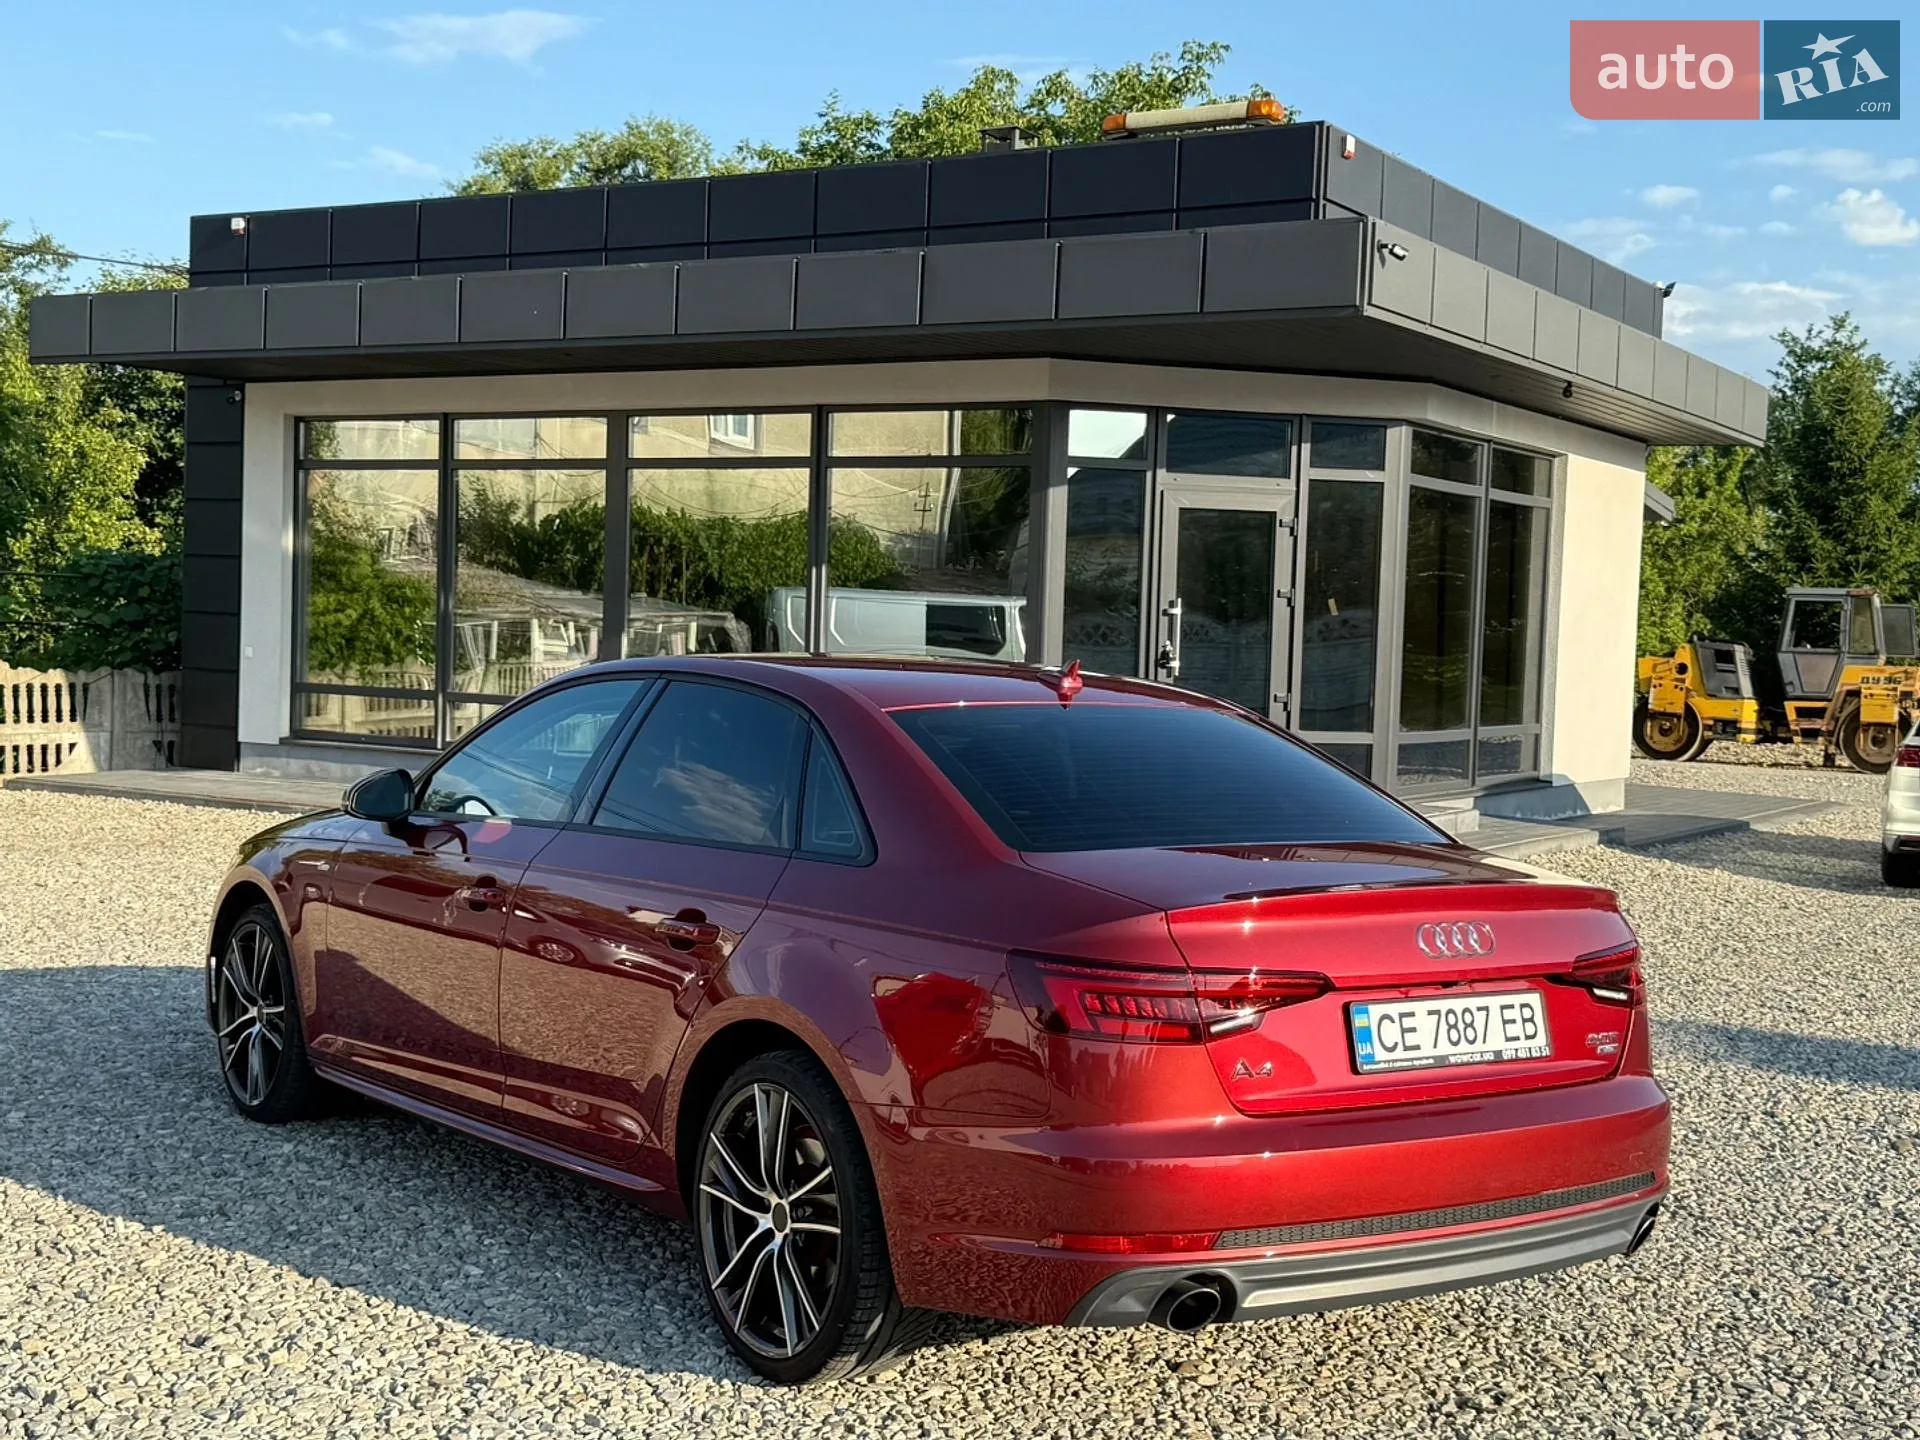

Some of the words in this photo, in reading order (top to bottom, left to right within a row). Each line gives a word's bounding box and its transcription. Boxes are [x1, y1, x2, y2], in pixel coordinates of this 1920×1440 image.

[1377, 1011, 1421, 1053] CE
[1427, 1005, 1490, 1049] 7887
[1500, 1003, 1538, 1042] EB
[1358, 1042, 1373, 1056] UA
[1231, 1057, 1273, 1080] A4
